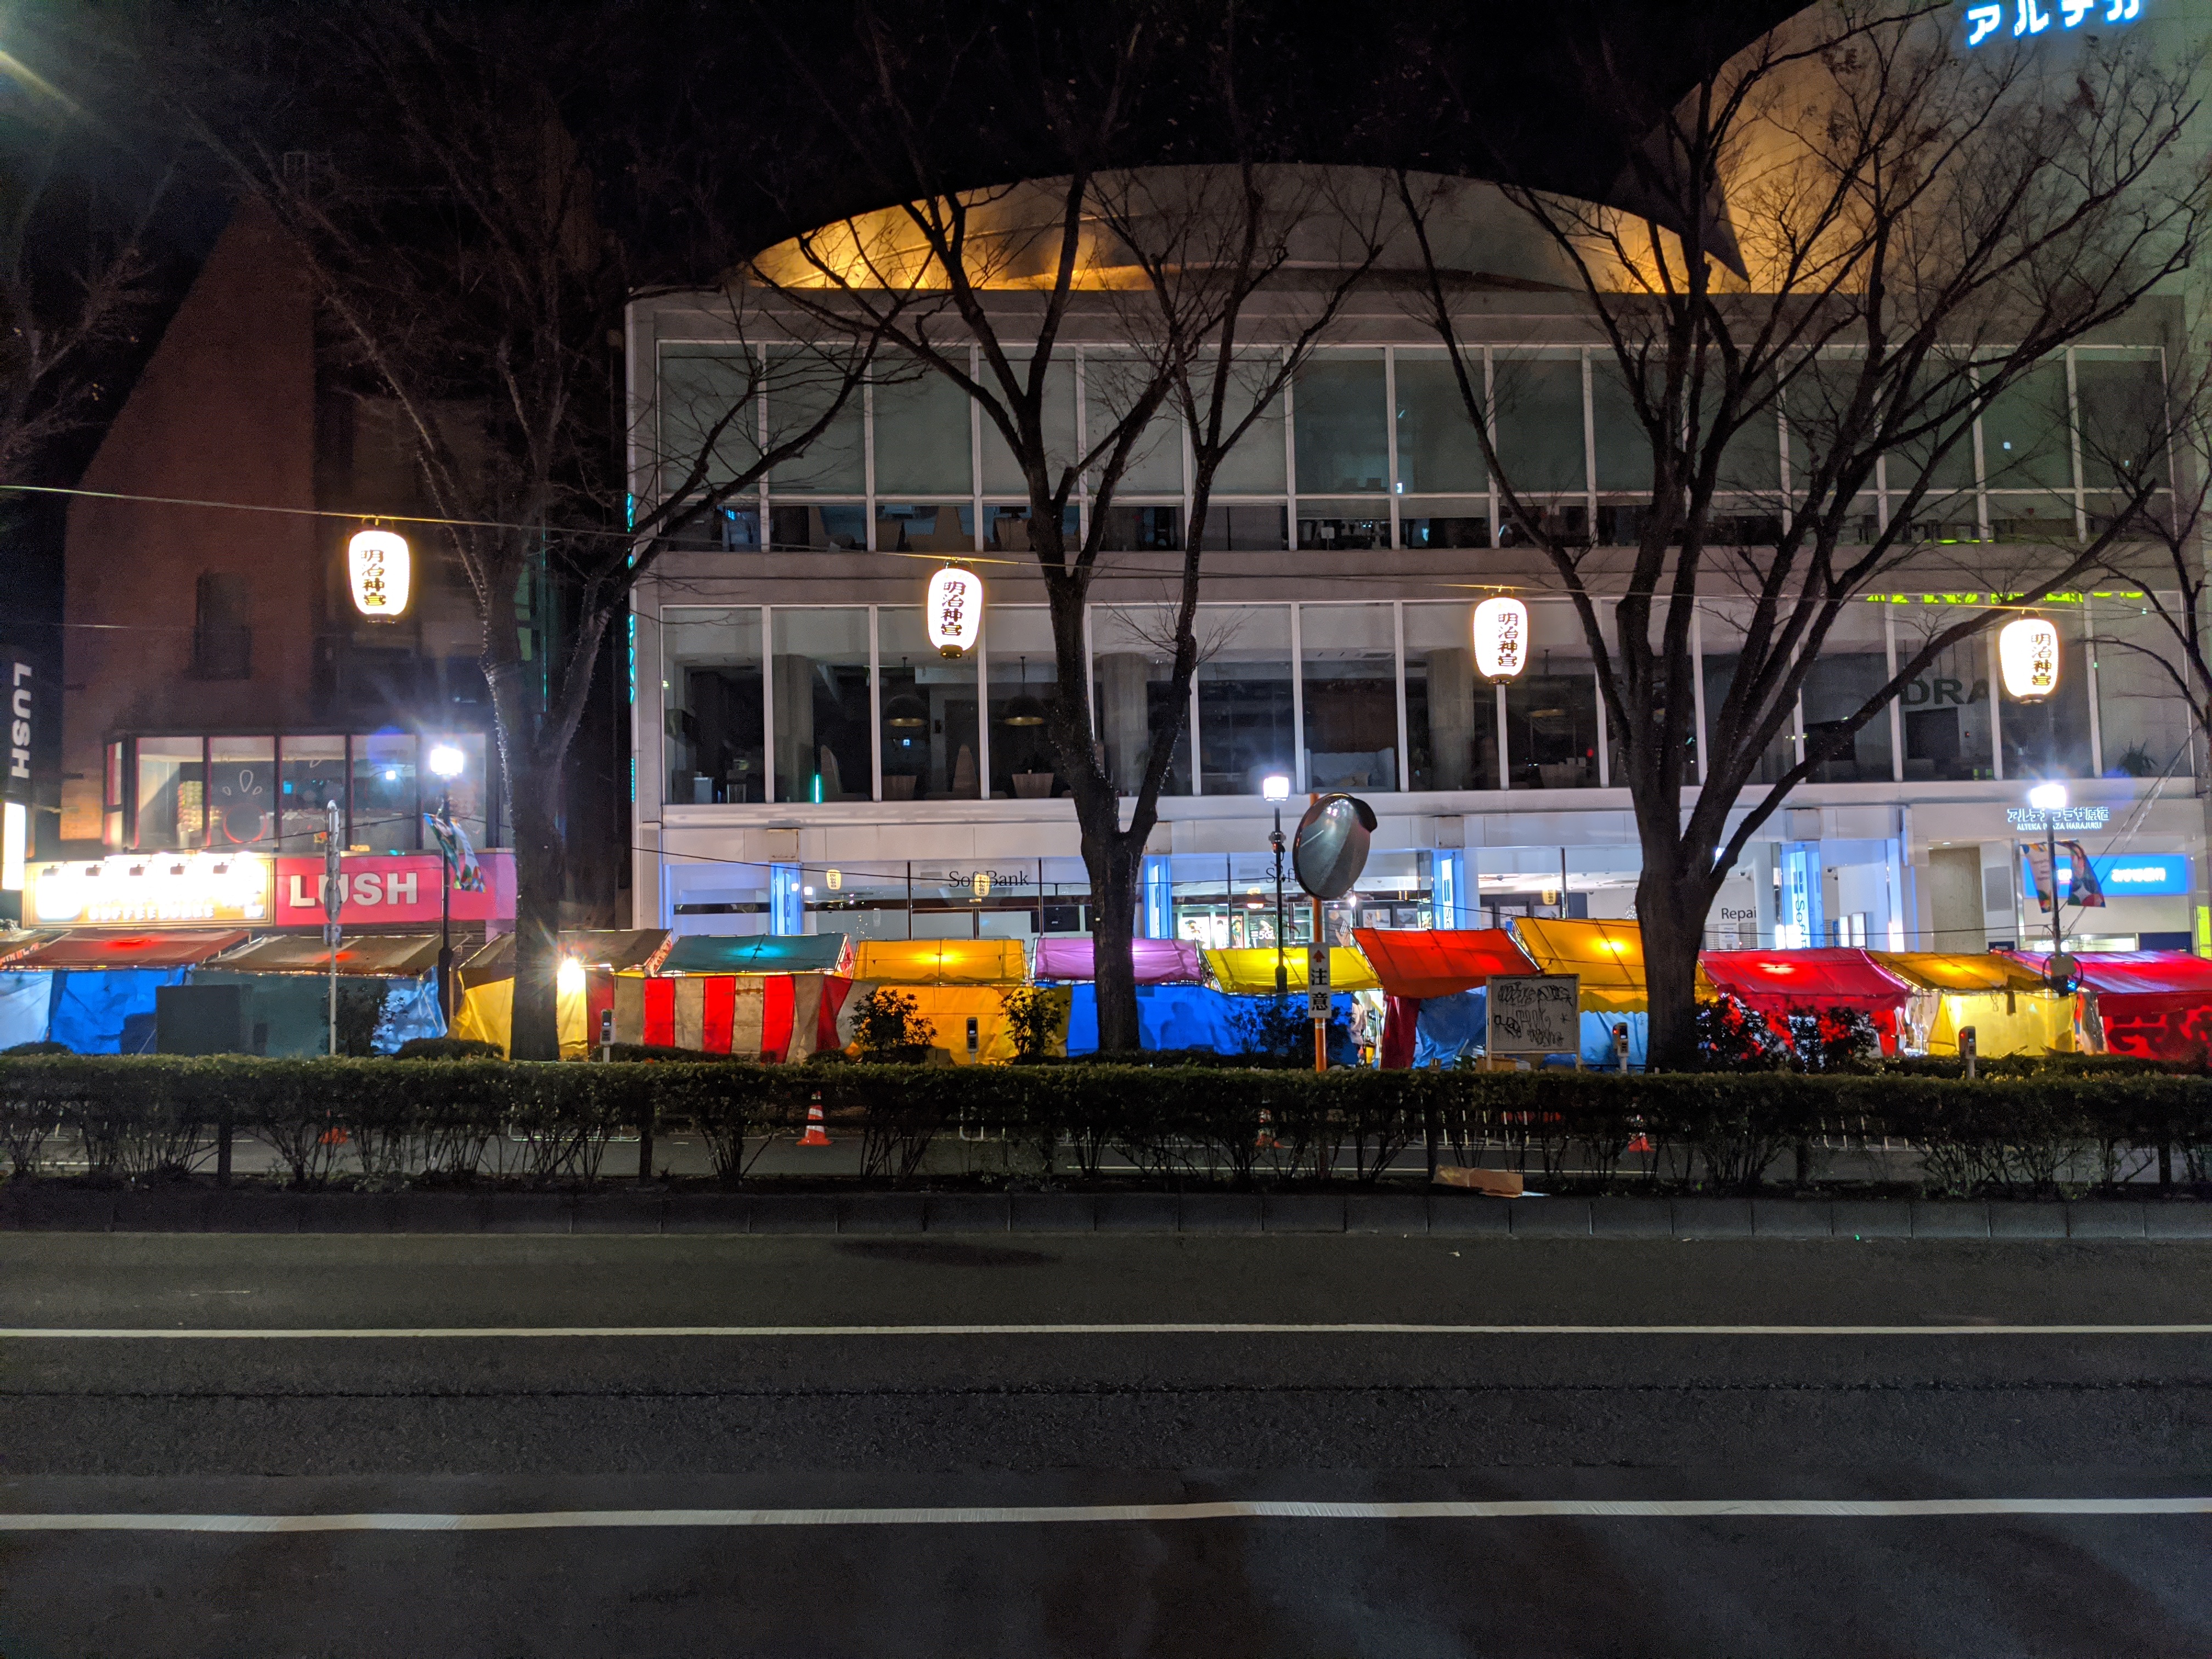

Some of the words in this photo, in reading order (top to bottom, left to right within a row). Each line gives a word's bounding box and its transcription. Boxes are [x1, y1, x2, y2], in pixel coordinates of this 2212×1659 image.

[360, 549, 386, 606] 明治神宮
[941, 581, 966, 636] 明治神宮
[1498, 612, 1519, 667] 明治神宮
[2031, 633, 2052, 686] 明治神宮
[11, 662, 32, 778] LUSH
[290, 872, 417, 907] LUSH
[949, 871, 1029, 888] SofBank
[1311, 968, 1328, 1011] 注意
